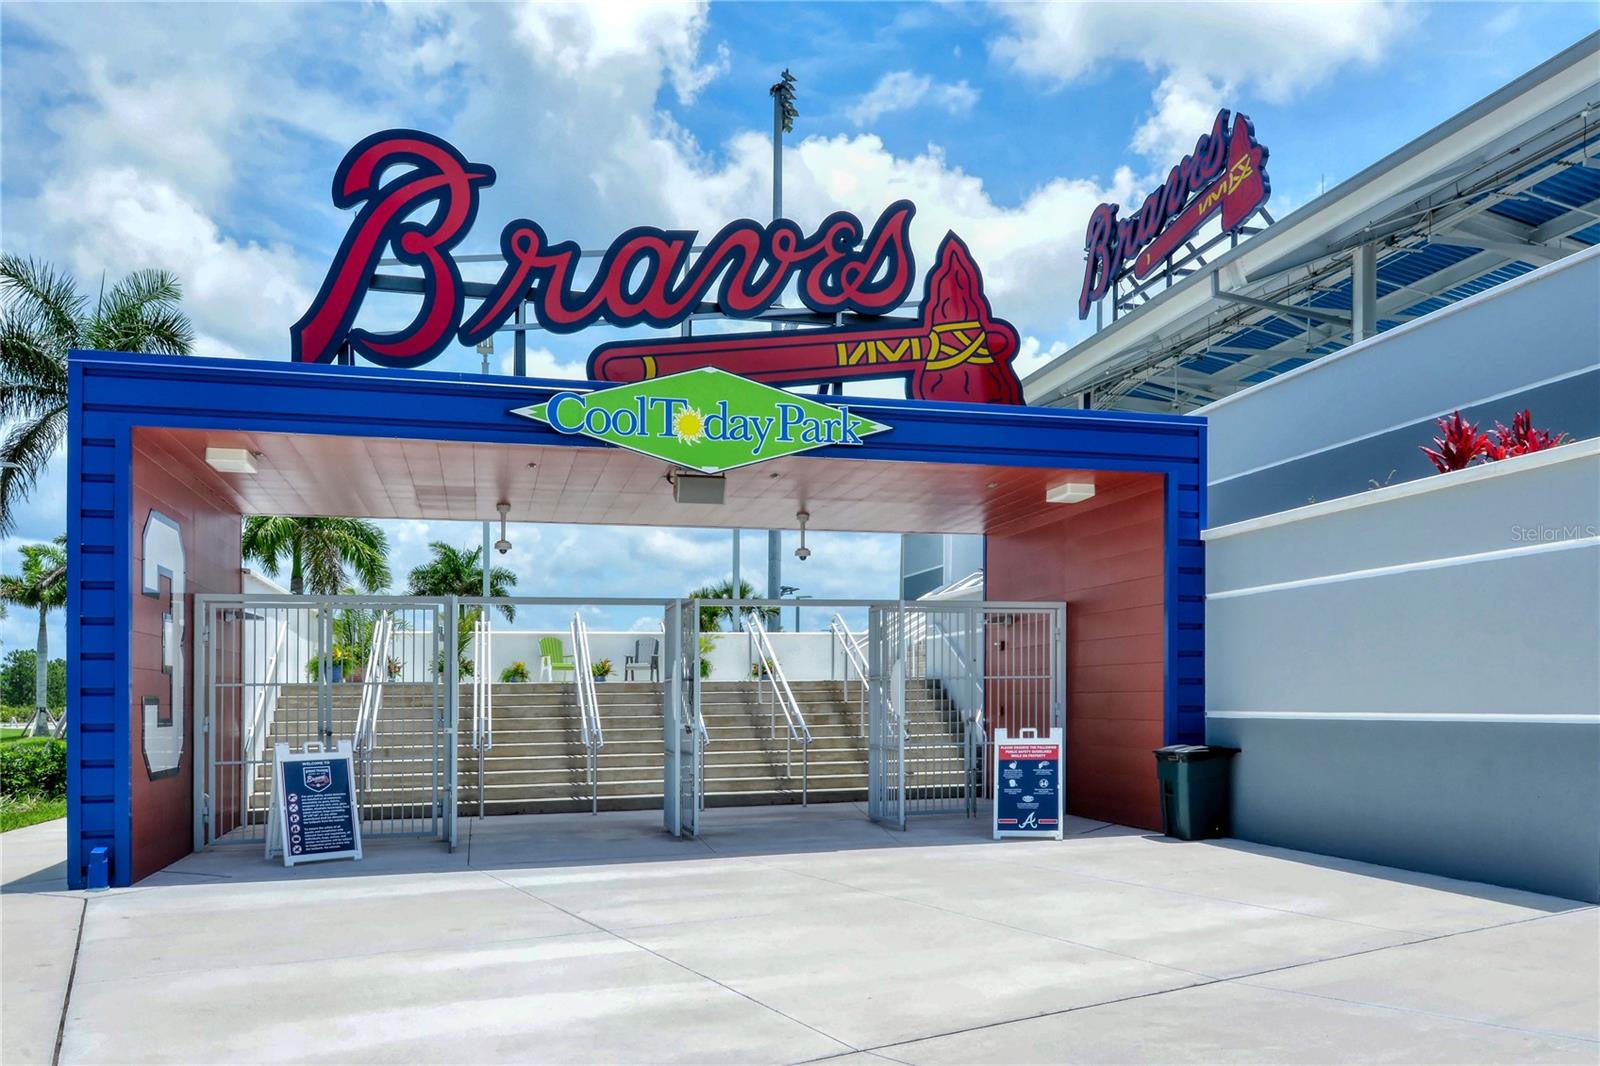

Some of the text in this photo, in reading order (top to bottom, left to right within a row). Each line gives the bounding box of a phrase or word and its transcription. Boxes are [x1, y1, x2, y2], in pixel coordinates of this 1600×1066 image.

[290, 127, 916, 368] Braves
[1079, 108, 1231, 320] Braves
[776, 402, 863, 446] Park
[141, 508, 186, 781] 3
[1018, 811, 1038, 828] A
